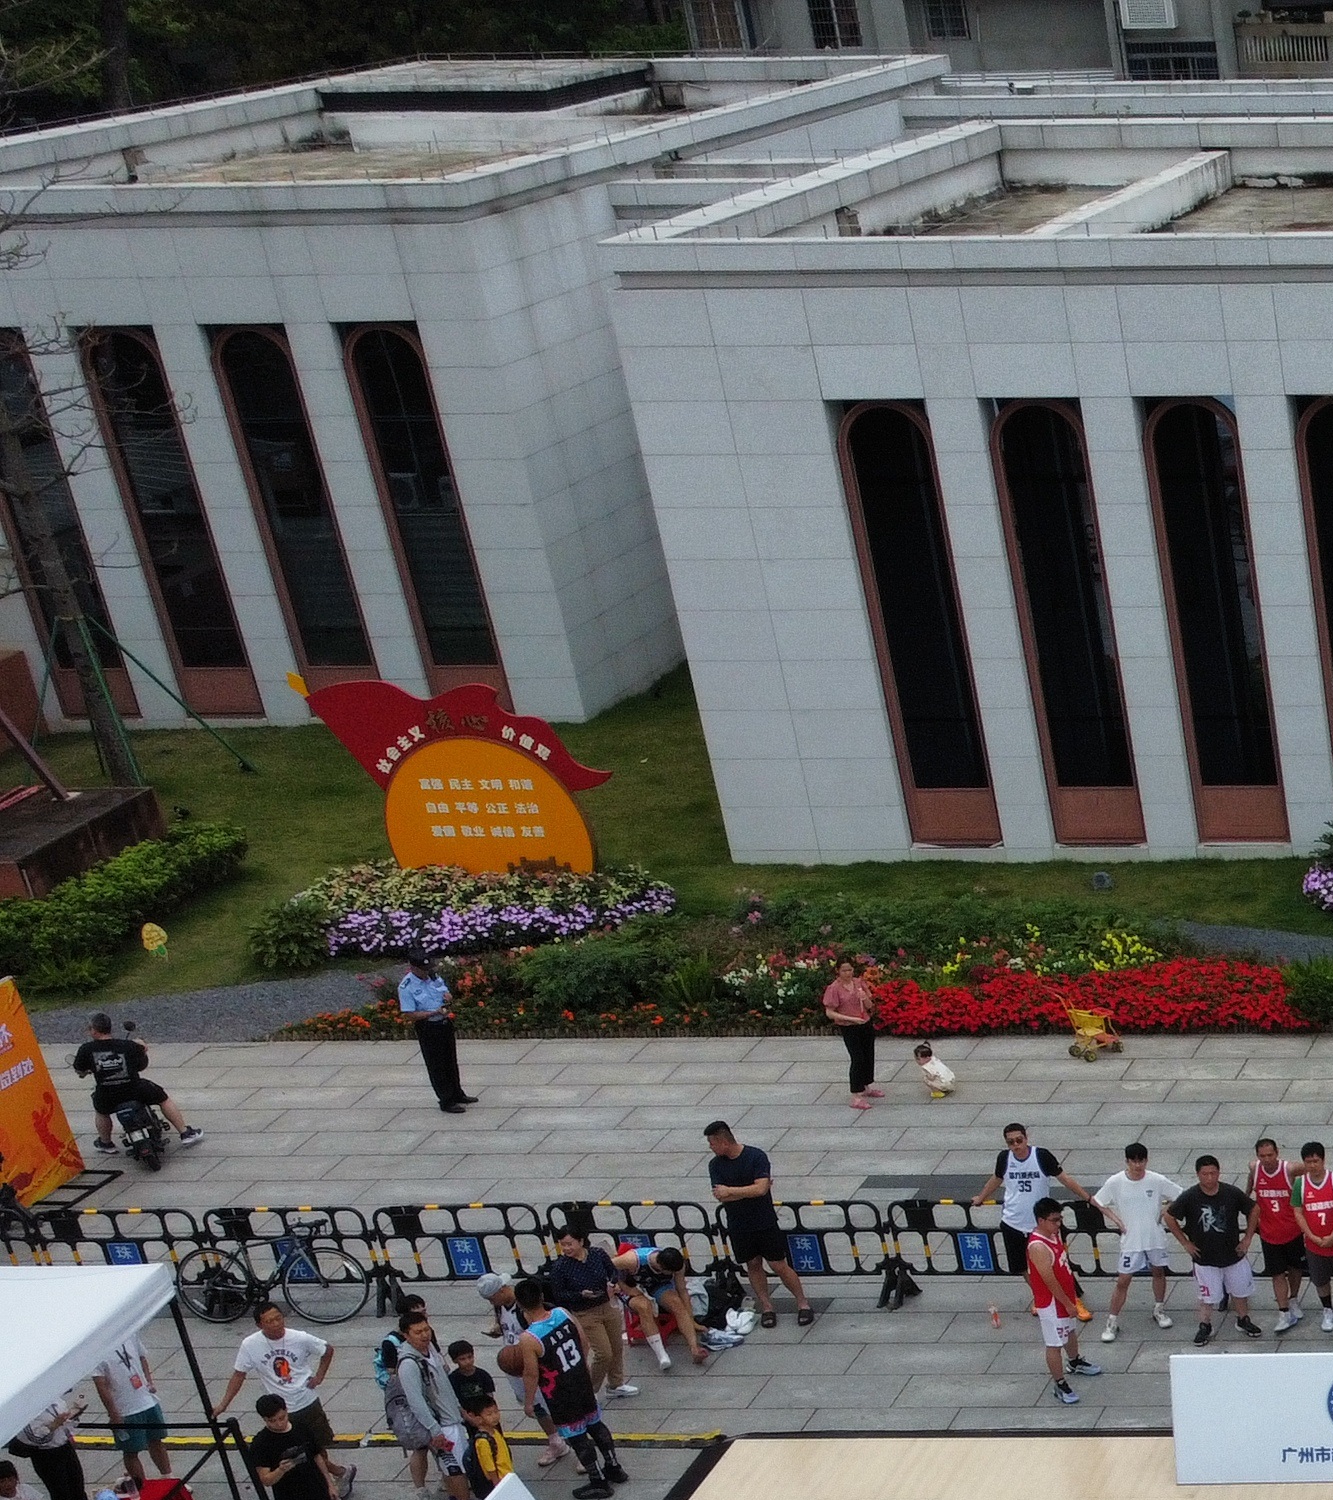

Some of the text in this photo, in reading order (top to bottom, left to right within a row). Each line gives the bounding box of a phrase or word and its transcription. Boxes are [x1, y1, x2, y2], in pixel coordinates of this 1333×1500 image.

[375, 725, 426, 774] 社会主义
[501, 725, 551, 761] 价值观
[418, 778, 534, 791] 富强 民主 文明 和谐
[425, 802, 539, 814] 自由 平等 公正 法治
[1018, 1180, 1032, 1193] 35
[1270, 1200, 1280, 1212] 3
[1317, 1212, 1327, 1226] 7
[453, 1239, 478, 1273] 珠光
[793, 1237, 816, 1269] 珠光
[964, 1236, 986, 1269] 珠光
[1123, 1256, 1131, 1268] 2
[556, 1338, 582, 1373] 13
